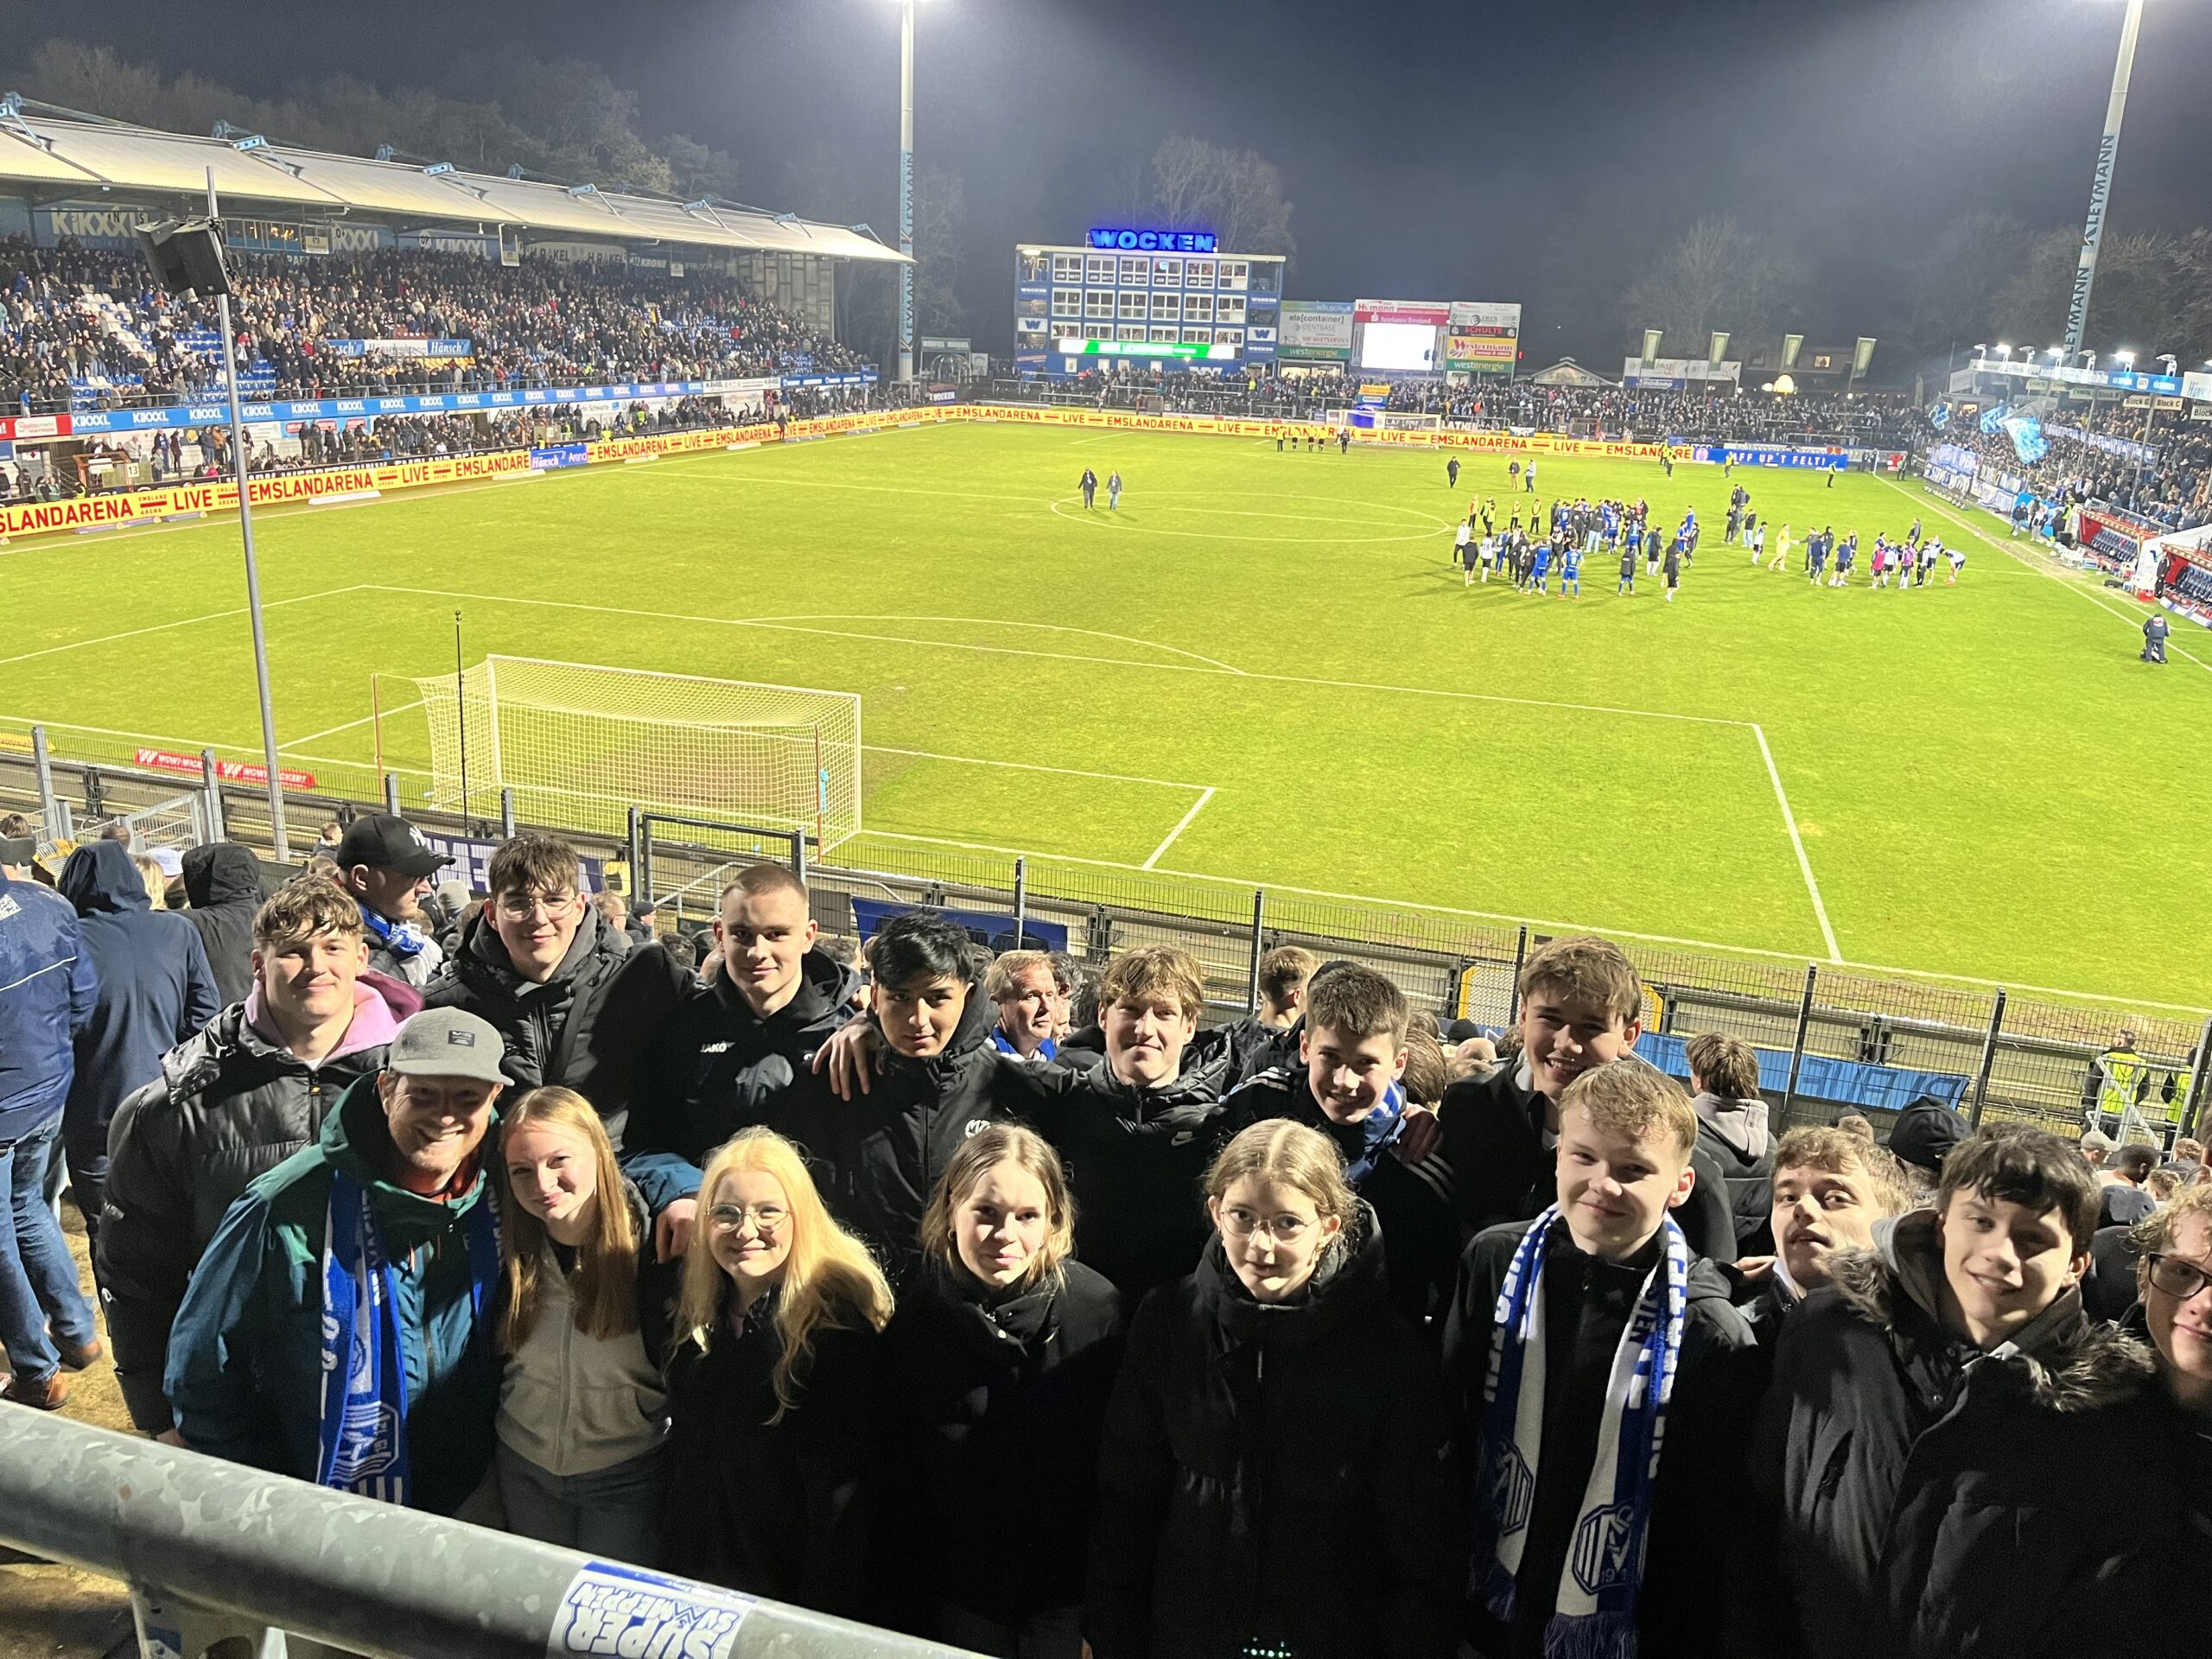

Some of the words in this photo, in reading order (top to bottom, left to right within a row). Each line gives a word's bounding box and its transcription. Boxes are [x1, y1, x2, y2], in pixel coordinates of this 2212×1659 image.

[1090, 229, 1214, 252] WOCKEN
[1465, 326, 1503, 334] SCHULTE
[431, 340, 462, 354] Hänsch
[1289, 348, 1338, 358] westenergie
[1454, 361, 1505, 372] westenergie
[809, 417, 855, 433] EMSLANDARENA
[957, 407, 1040, 421] EMSLANDARENA
[1062, 413, 1085, 424] LIVE
[1107, 416, 1194, 431] EMSLANDARENA
[1217, 423, 1242, 434] LIVE
[1381, 432, 1406, 442] LIVE
[1430, 434, 1527, 449] EMSLANDARENA
[1554, 441, 1580, 453] LIVE
[684, 439, 702, 449] LIVE
[715, 429, 772, 445] EMSLANDARENA
[597, 441, 668, 459] EMSLANDARENA
[455, 453, 530, 477] EMSLANDARE
[531, 454, 559, 469] Hänsch
[569, 451, 588, 463] Arena
[129, 466, 138, 475] 13
[402, 465, 429, 484] LIVE
[249, 471, 374, 503] EMSLANDARENA
[138, 493, 168, 503] EMSLAND
[174, 488, 213, 512] LIVE
[140, 506, 162, 515] ARENA
[700, 1042, 728, 1053] JAKO
[568, 1581, 677, 1622] MEPPEN
[696, 1606, 741, 1633] SV
[564, 1605, 720, 1659] SUPER
